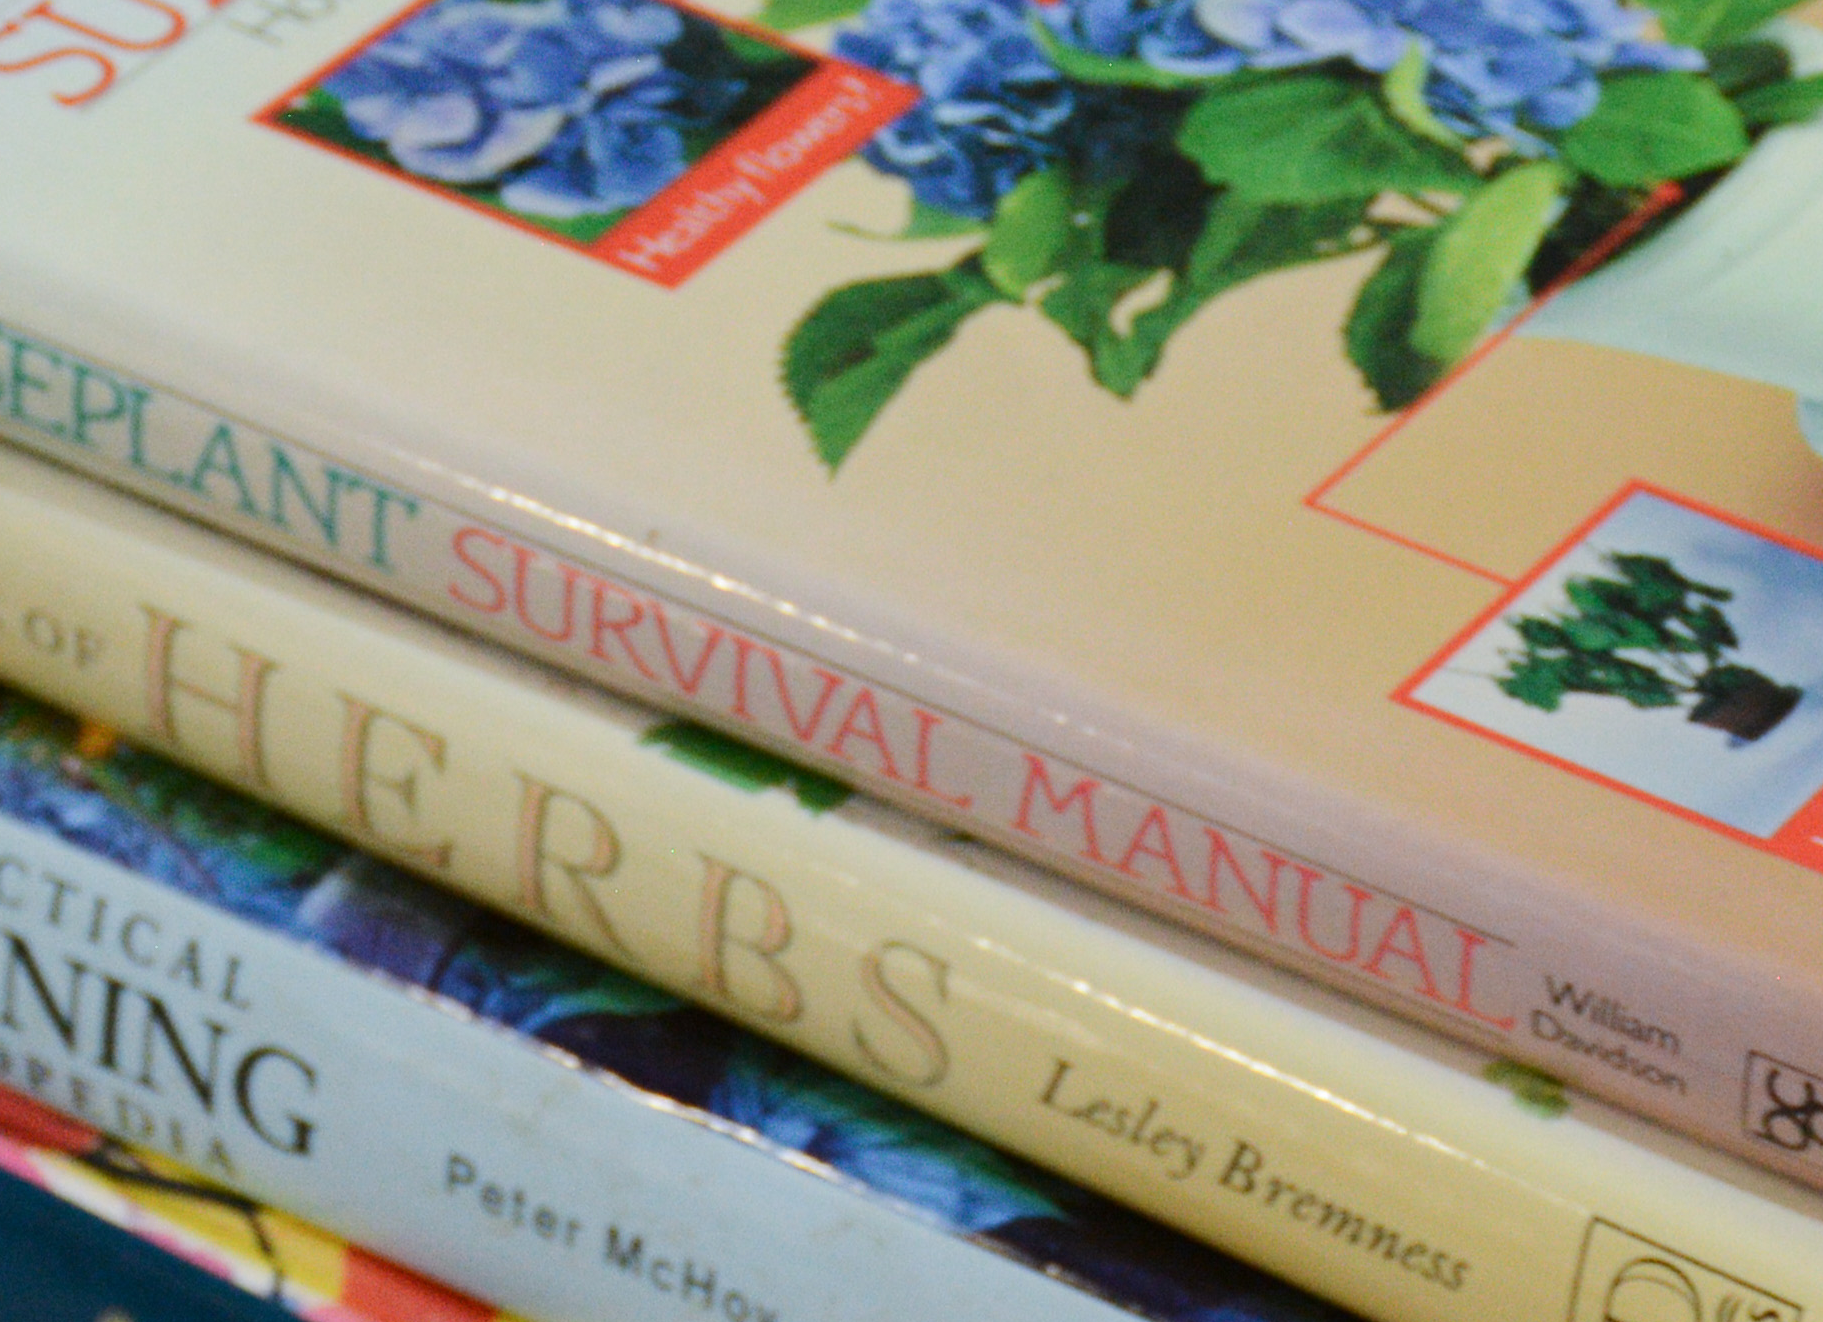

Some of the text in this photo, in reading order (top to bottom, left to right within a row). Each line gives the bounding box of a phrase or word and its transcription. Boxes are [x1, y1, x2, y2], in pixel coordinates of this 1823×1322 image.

[617, 176, 767, 271] Healthy
[448, 525, 973, 810] SURVIVAL
[1011, 752, 1517, 1034] MANUAL
[22, 605, 109, 676] OF
[137, 598, 952, 1091] HERBS
[1530, 1008, 1688, 1095] Davidson
[1545, 976, 1682, 1056] William
[446, 1151, 581, 1246] Peter
[1038, 1059, 1473, 1293] Lesley Bremness
